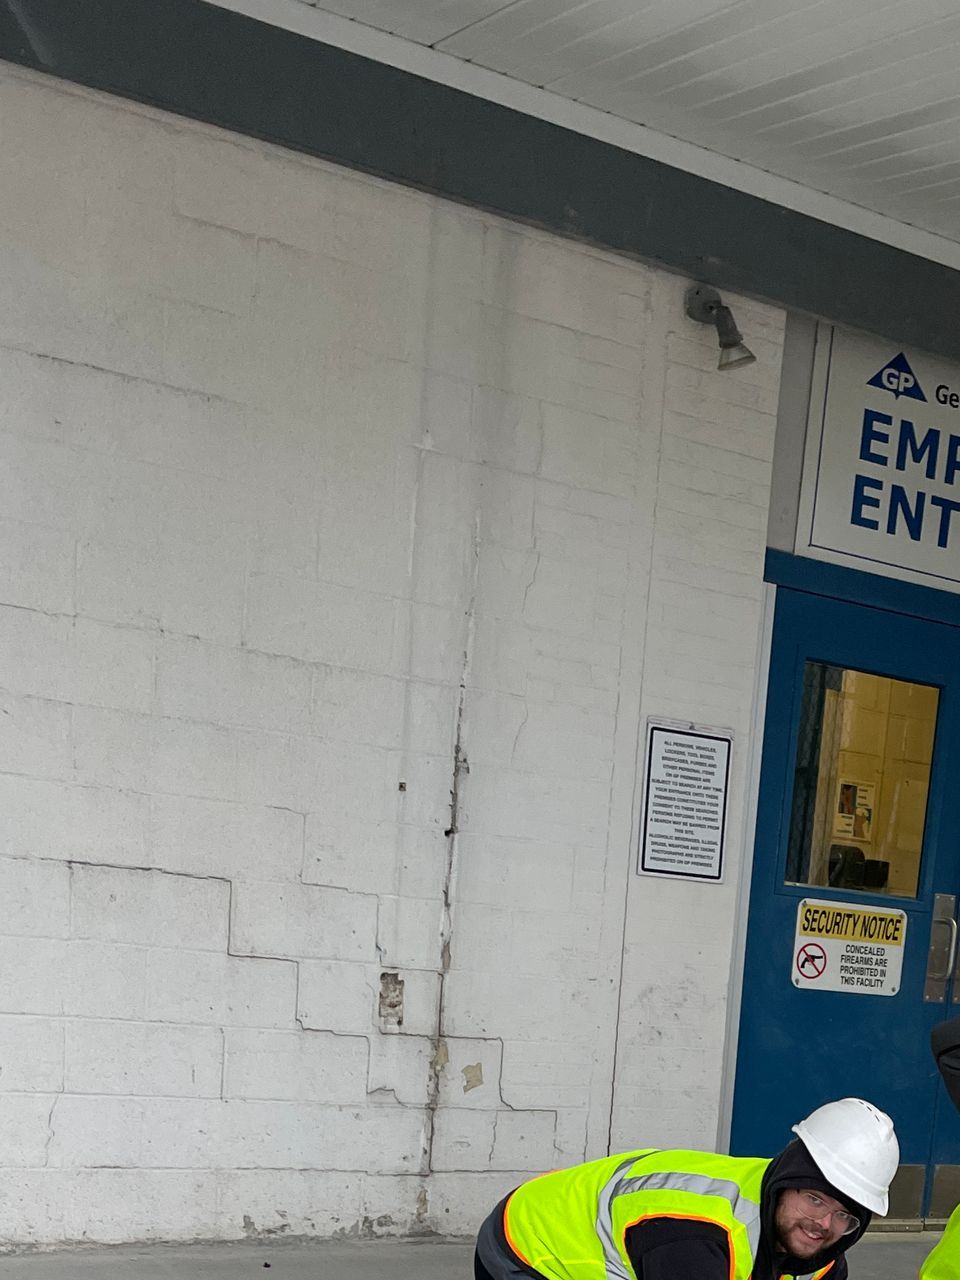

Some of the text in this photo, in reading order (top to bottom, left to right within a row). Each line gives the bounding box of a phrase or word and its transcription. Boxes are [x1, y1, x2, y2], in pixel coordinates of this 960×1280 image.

[881, 367, 915, 392] GP
[802, 908, 902, 941] SECURITY NOTICE
[845, 944, 885, 956] CONCEALED
[840, 954, 888, 968] FIREARMS ARE
[840, 965, 887, 978] PROHIBITED IN
[840, 975, 885, 988] THIS FACILITY
